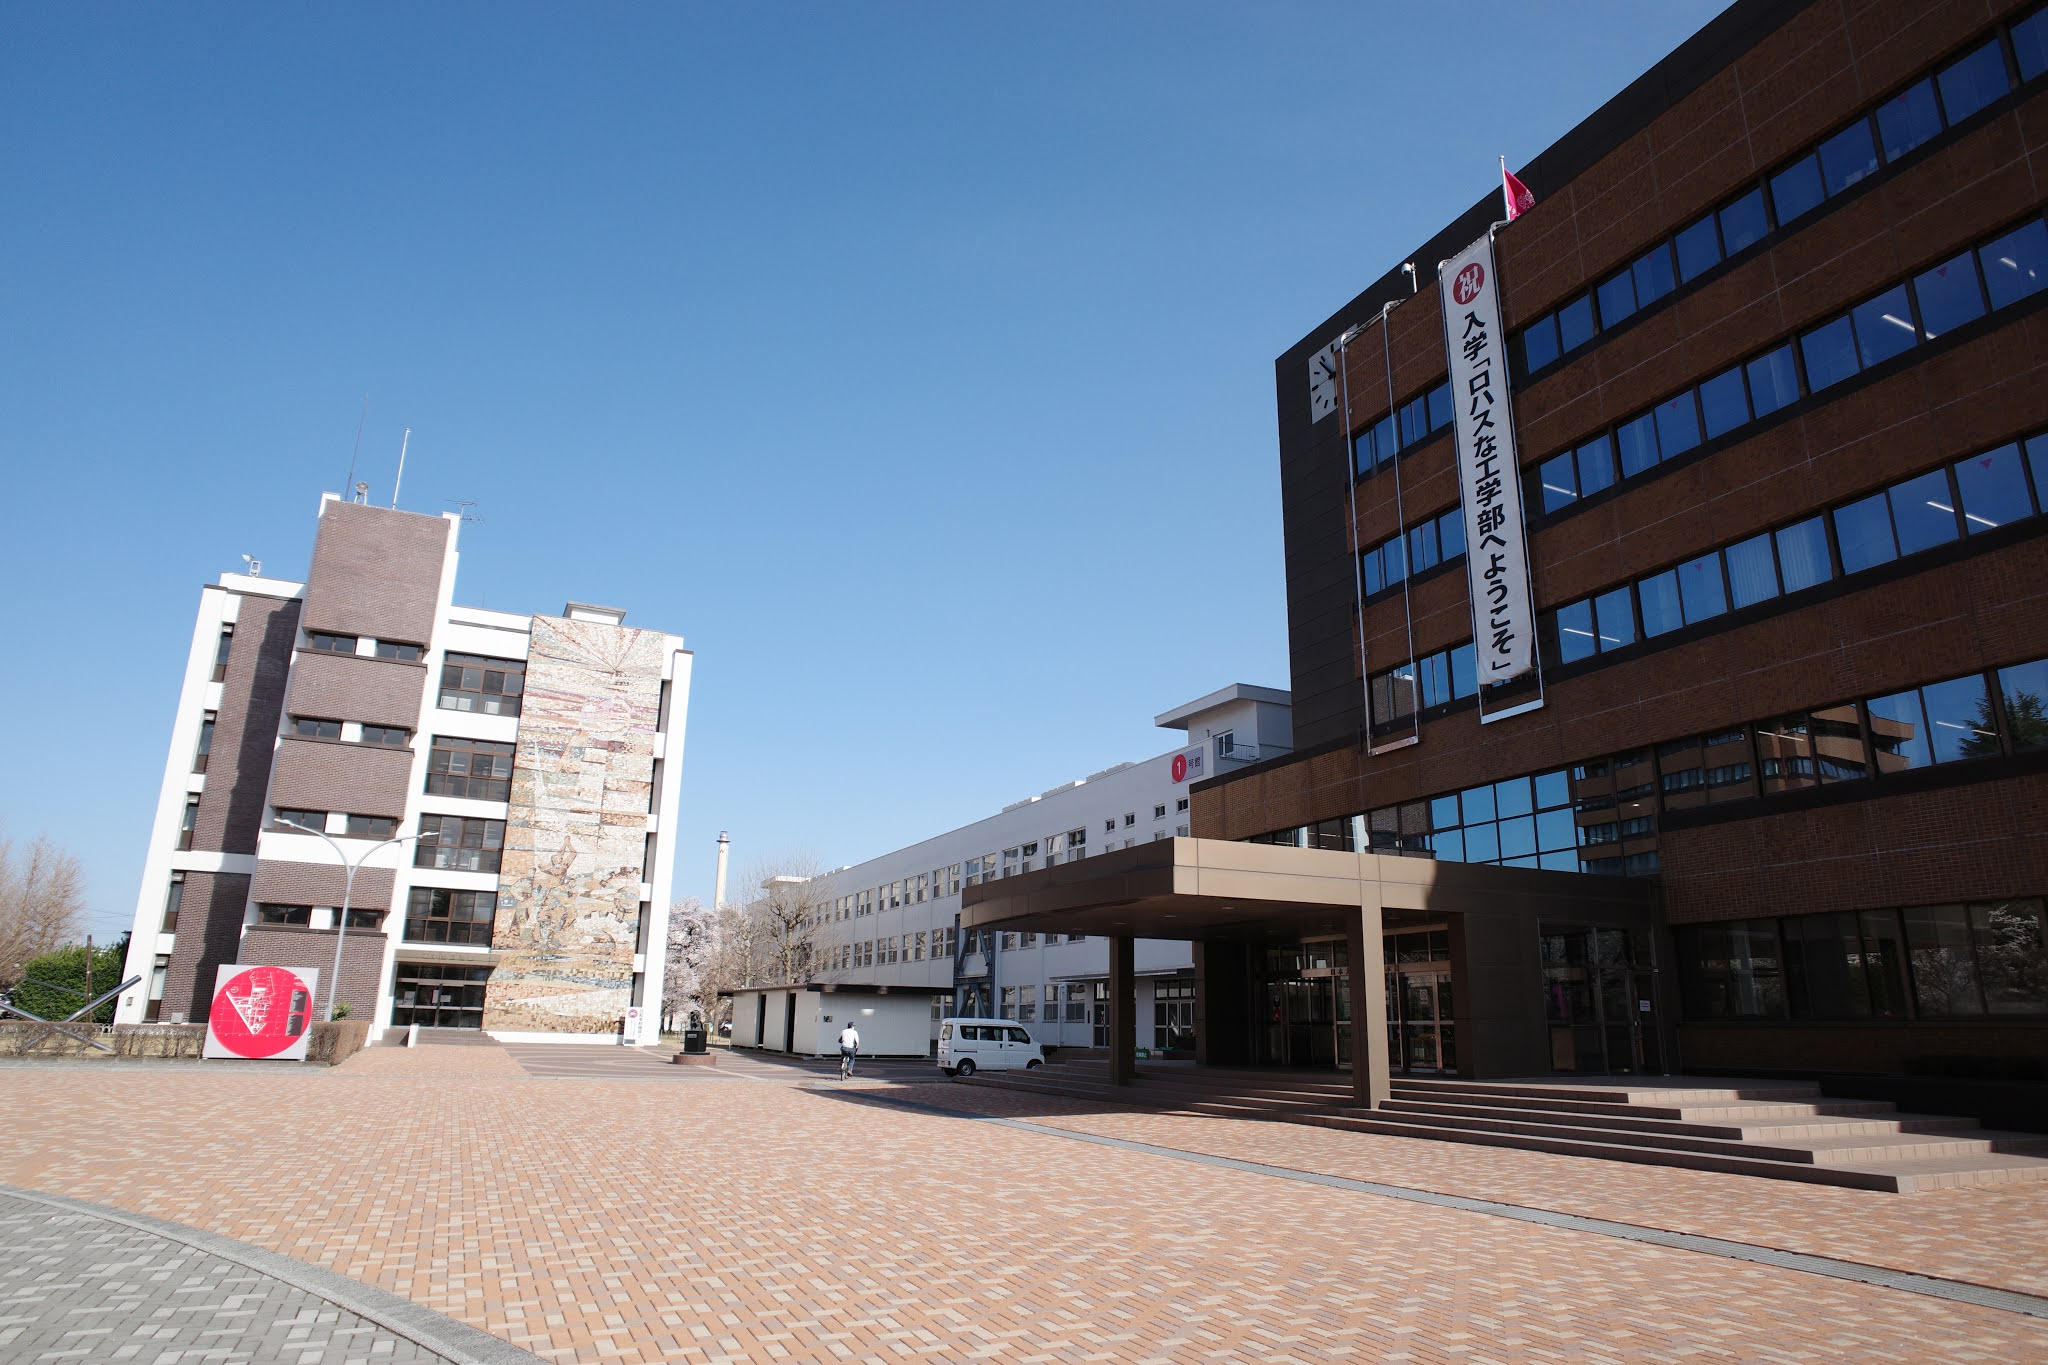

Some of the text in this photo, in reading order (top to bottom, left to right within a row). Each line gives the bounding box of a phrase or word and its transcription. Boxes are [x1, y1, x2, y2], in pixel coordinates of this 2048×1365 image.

[1457, 265, 1481, 303] 祝
[1462, 310, 1515, 671] 入学「ロハスな工学部へようこそ」
